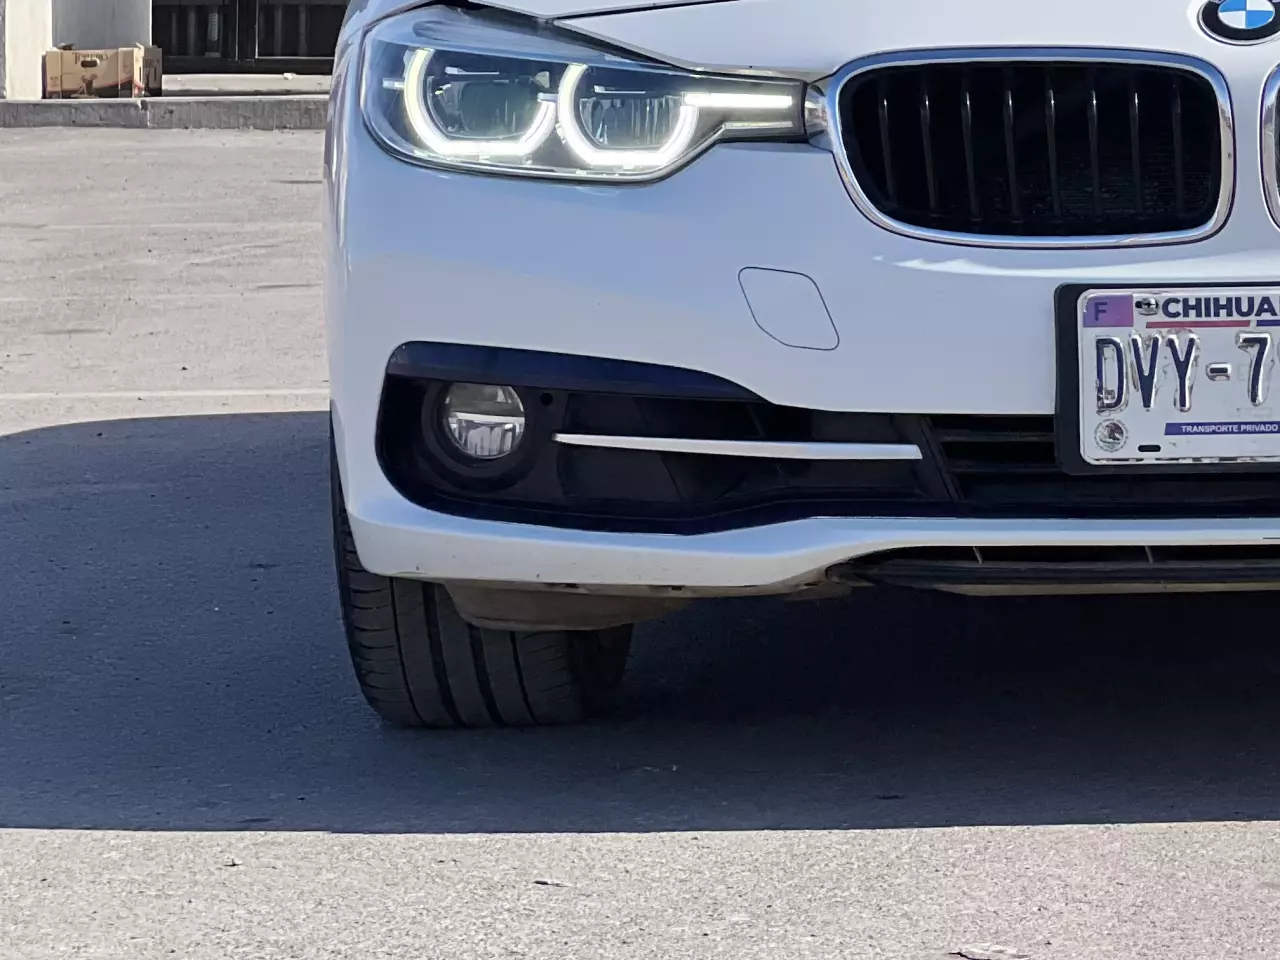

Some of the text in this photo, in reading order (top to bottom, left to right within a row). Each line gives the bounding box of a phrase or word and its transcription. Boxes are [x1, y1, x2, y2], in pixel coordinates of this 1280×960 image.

[1093, 301, 1109, 321] F
[1180, 424, 1239, 433] TRANSPORTE
[1240, 423, 1278, 432] PRIVADO
